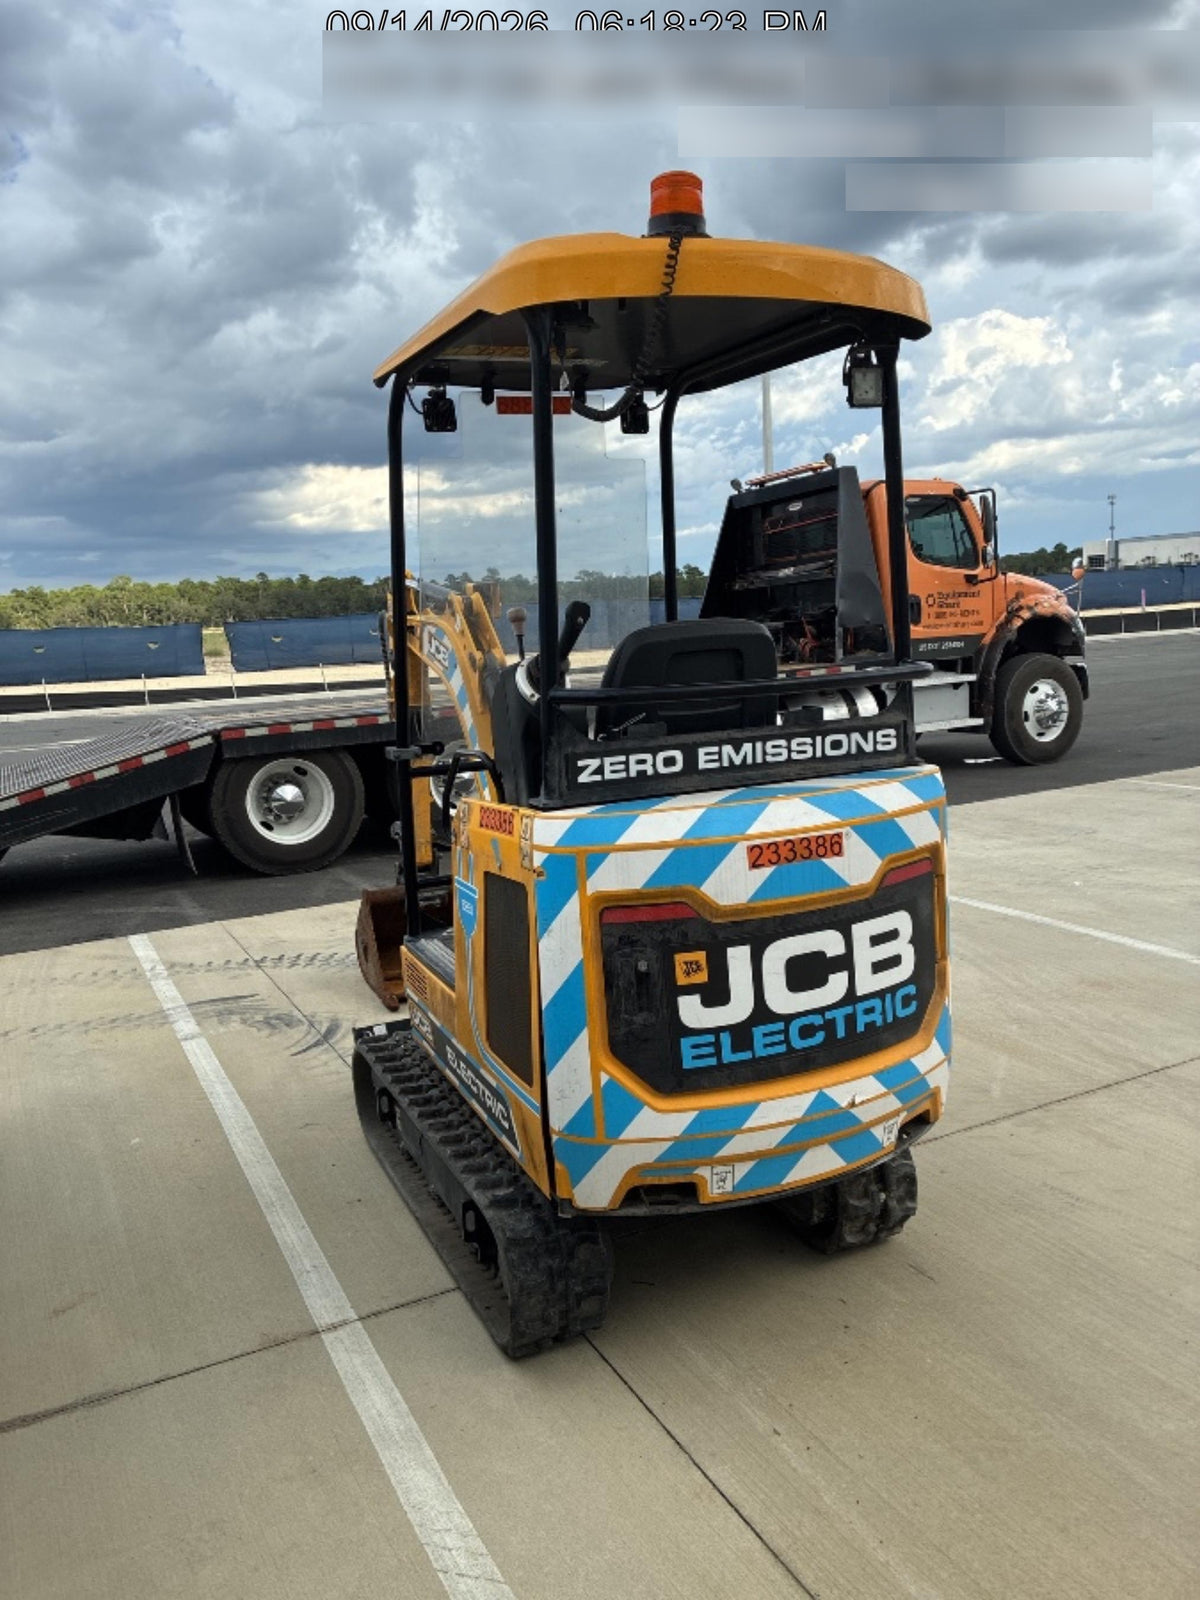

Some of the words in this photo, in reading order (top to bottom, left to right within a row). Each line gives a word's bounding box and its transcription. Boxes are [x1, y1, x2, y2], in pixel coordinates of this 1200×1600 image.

[577, 750, 684, 784] ZERO
[698, 728, 897, 770] EMISSIONS
[749, 834, 843, 869] 233386
[677, 910, 916, 1029] JCB
[680, 984, 917, 1070] ELECTRIC
[445, 1044, 510, 1130] ELECTRIC
